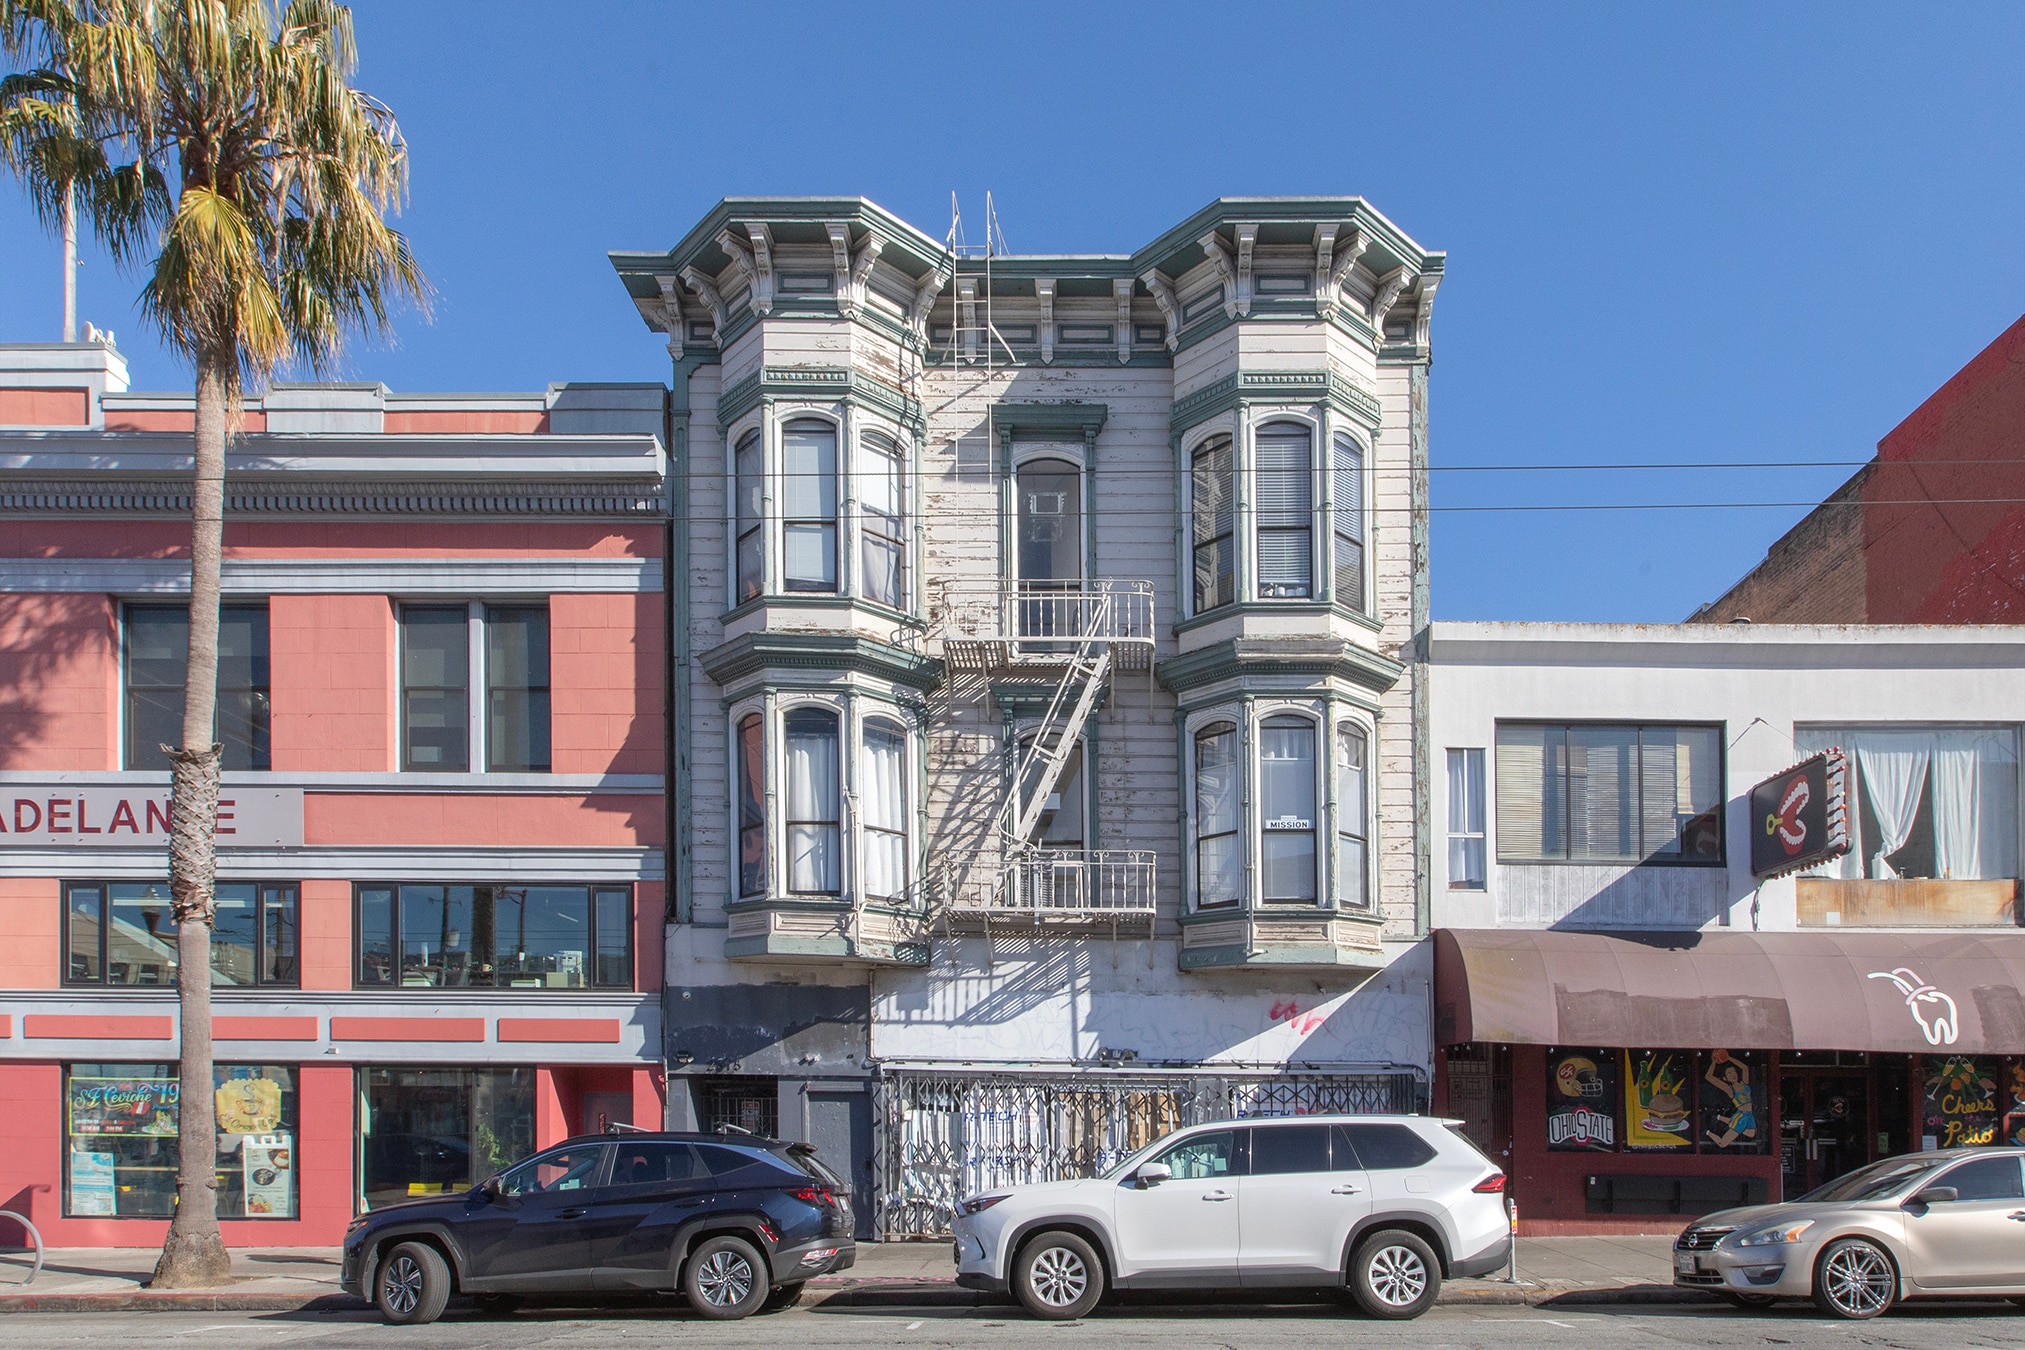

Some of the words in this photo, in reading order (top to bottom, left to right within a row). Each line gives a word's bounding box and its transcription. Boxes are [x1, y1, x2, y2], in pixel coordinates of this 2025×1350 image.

[0, 799, 236, 834] DELANE
[1270, 821, 1308, 829] MISSION
[1560, 1065, 1574, 1078] SF
[104, 1083, 153, 1112] Ceviche
[1942, 1094, 1997, 1114] Cheers
[1550, 1114, 1577, 1142] OHIO
[1577, 1111, 1612, 1143] STATE
[1943, 1121, 1994, 1147] Patio
